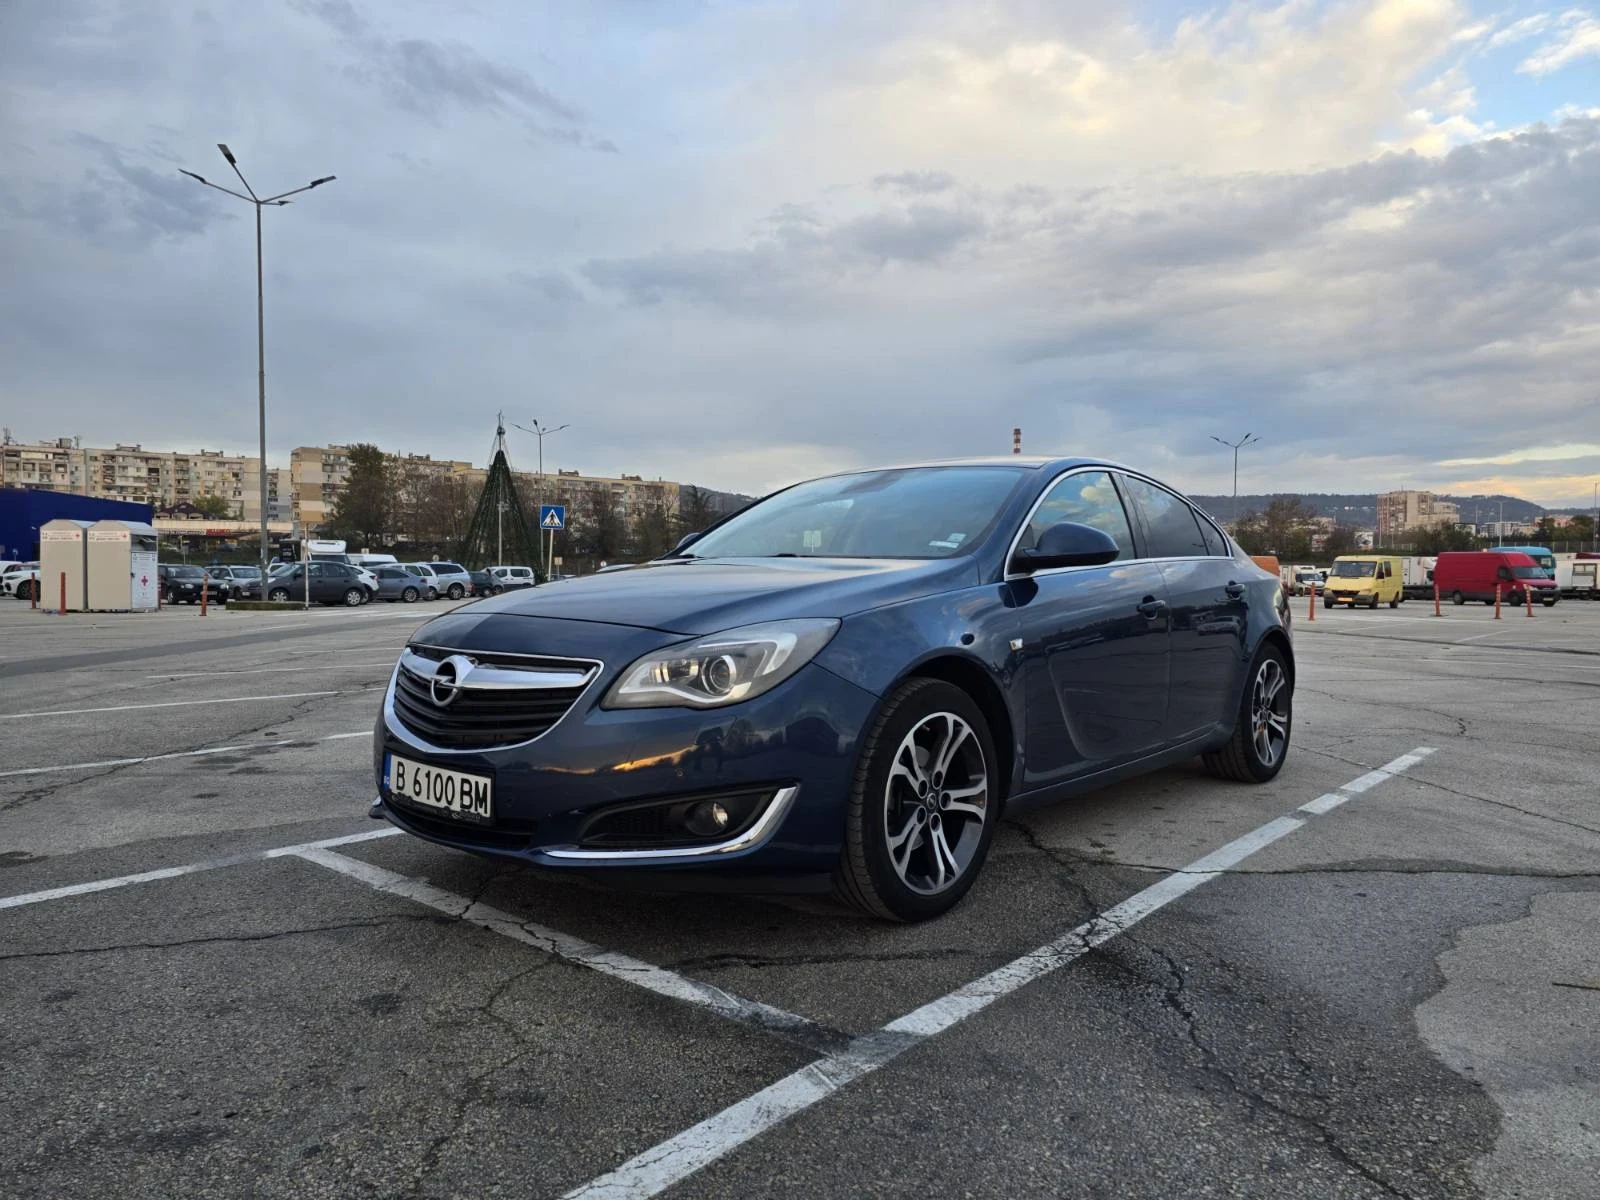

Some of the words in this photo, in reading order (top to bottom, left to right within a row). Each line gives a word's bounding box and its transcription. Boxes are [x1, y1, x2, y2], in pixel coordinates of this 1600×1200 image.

[396, 761, 406, 791] B
[413, 767, 456, 806] 6100
[460, 778, 488, 815] BM
